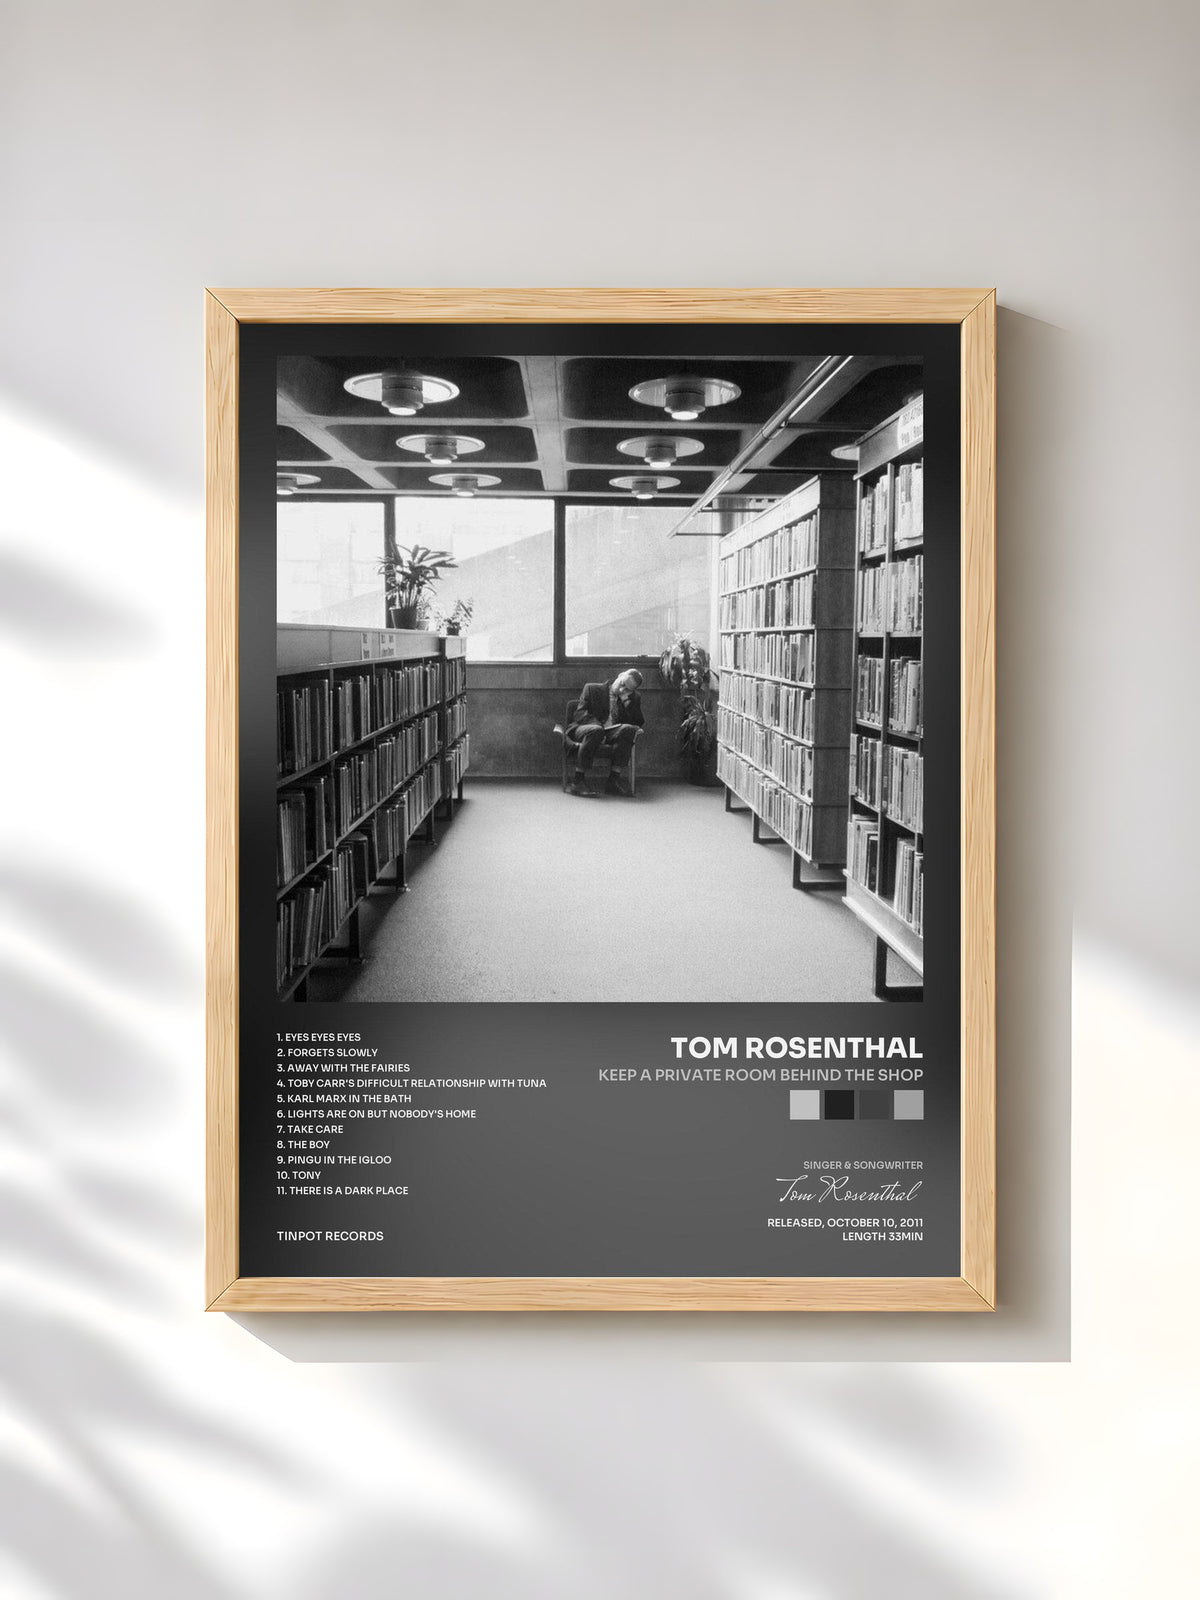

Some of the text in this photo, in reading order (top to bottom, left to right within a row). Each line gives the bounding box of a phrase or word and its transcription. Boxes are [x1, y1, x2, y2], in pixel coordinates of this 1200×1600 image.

[277, 1032, 362, 1042] 1. EYES EYES EYES
[277, 1047, 379, 1057] 2. FORGETS SLOWLY
[670, 1036, 924, 1059] TOM ROSENTHAL
[277, 1063, 411, 1073] 3. AWAY WITH THE FAIRIES
[598, 1068, 924, 1082] KEEP A PRIVATE ROOM BEHIND THE SHOP
[277, 1078, 547, 1088] 4. TOBY CARR'S DIFFICULT RELATIONSHIP WITH TUNA
[277, 1094, 412, 1103] 5. KARL MARX IN THE BATH
[277, 1109, 477, 1119] 6. LIGHTS ARE ON BUT NOBODY'S HOME
[277, 1124, 344, 1134] 7. TAKE CARE
[277, 1139, 331, 1149] 8. THE BOY
[277, 1155, 392, 1165] 9. PINGU IN THE IGLOO
[803, 1160, 924, 1170] SINGER & SONGWRITER
[276, 1170, 322, 1180] 10. TONY
[277, 1185, 409, 1195] 11. THERE IS A DARK PLACE
[776, 1174, 923, 1203] Tom Rosenthal
[767, 1217, 924, 1229] RELEASED, OCTOBER 10, 2011
[276, 1230, 384, 1242] TINPOT RECORDS
[842, 1231, 924, 1242] LENGTH 33MIN
